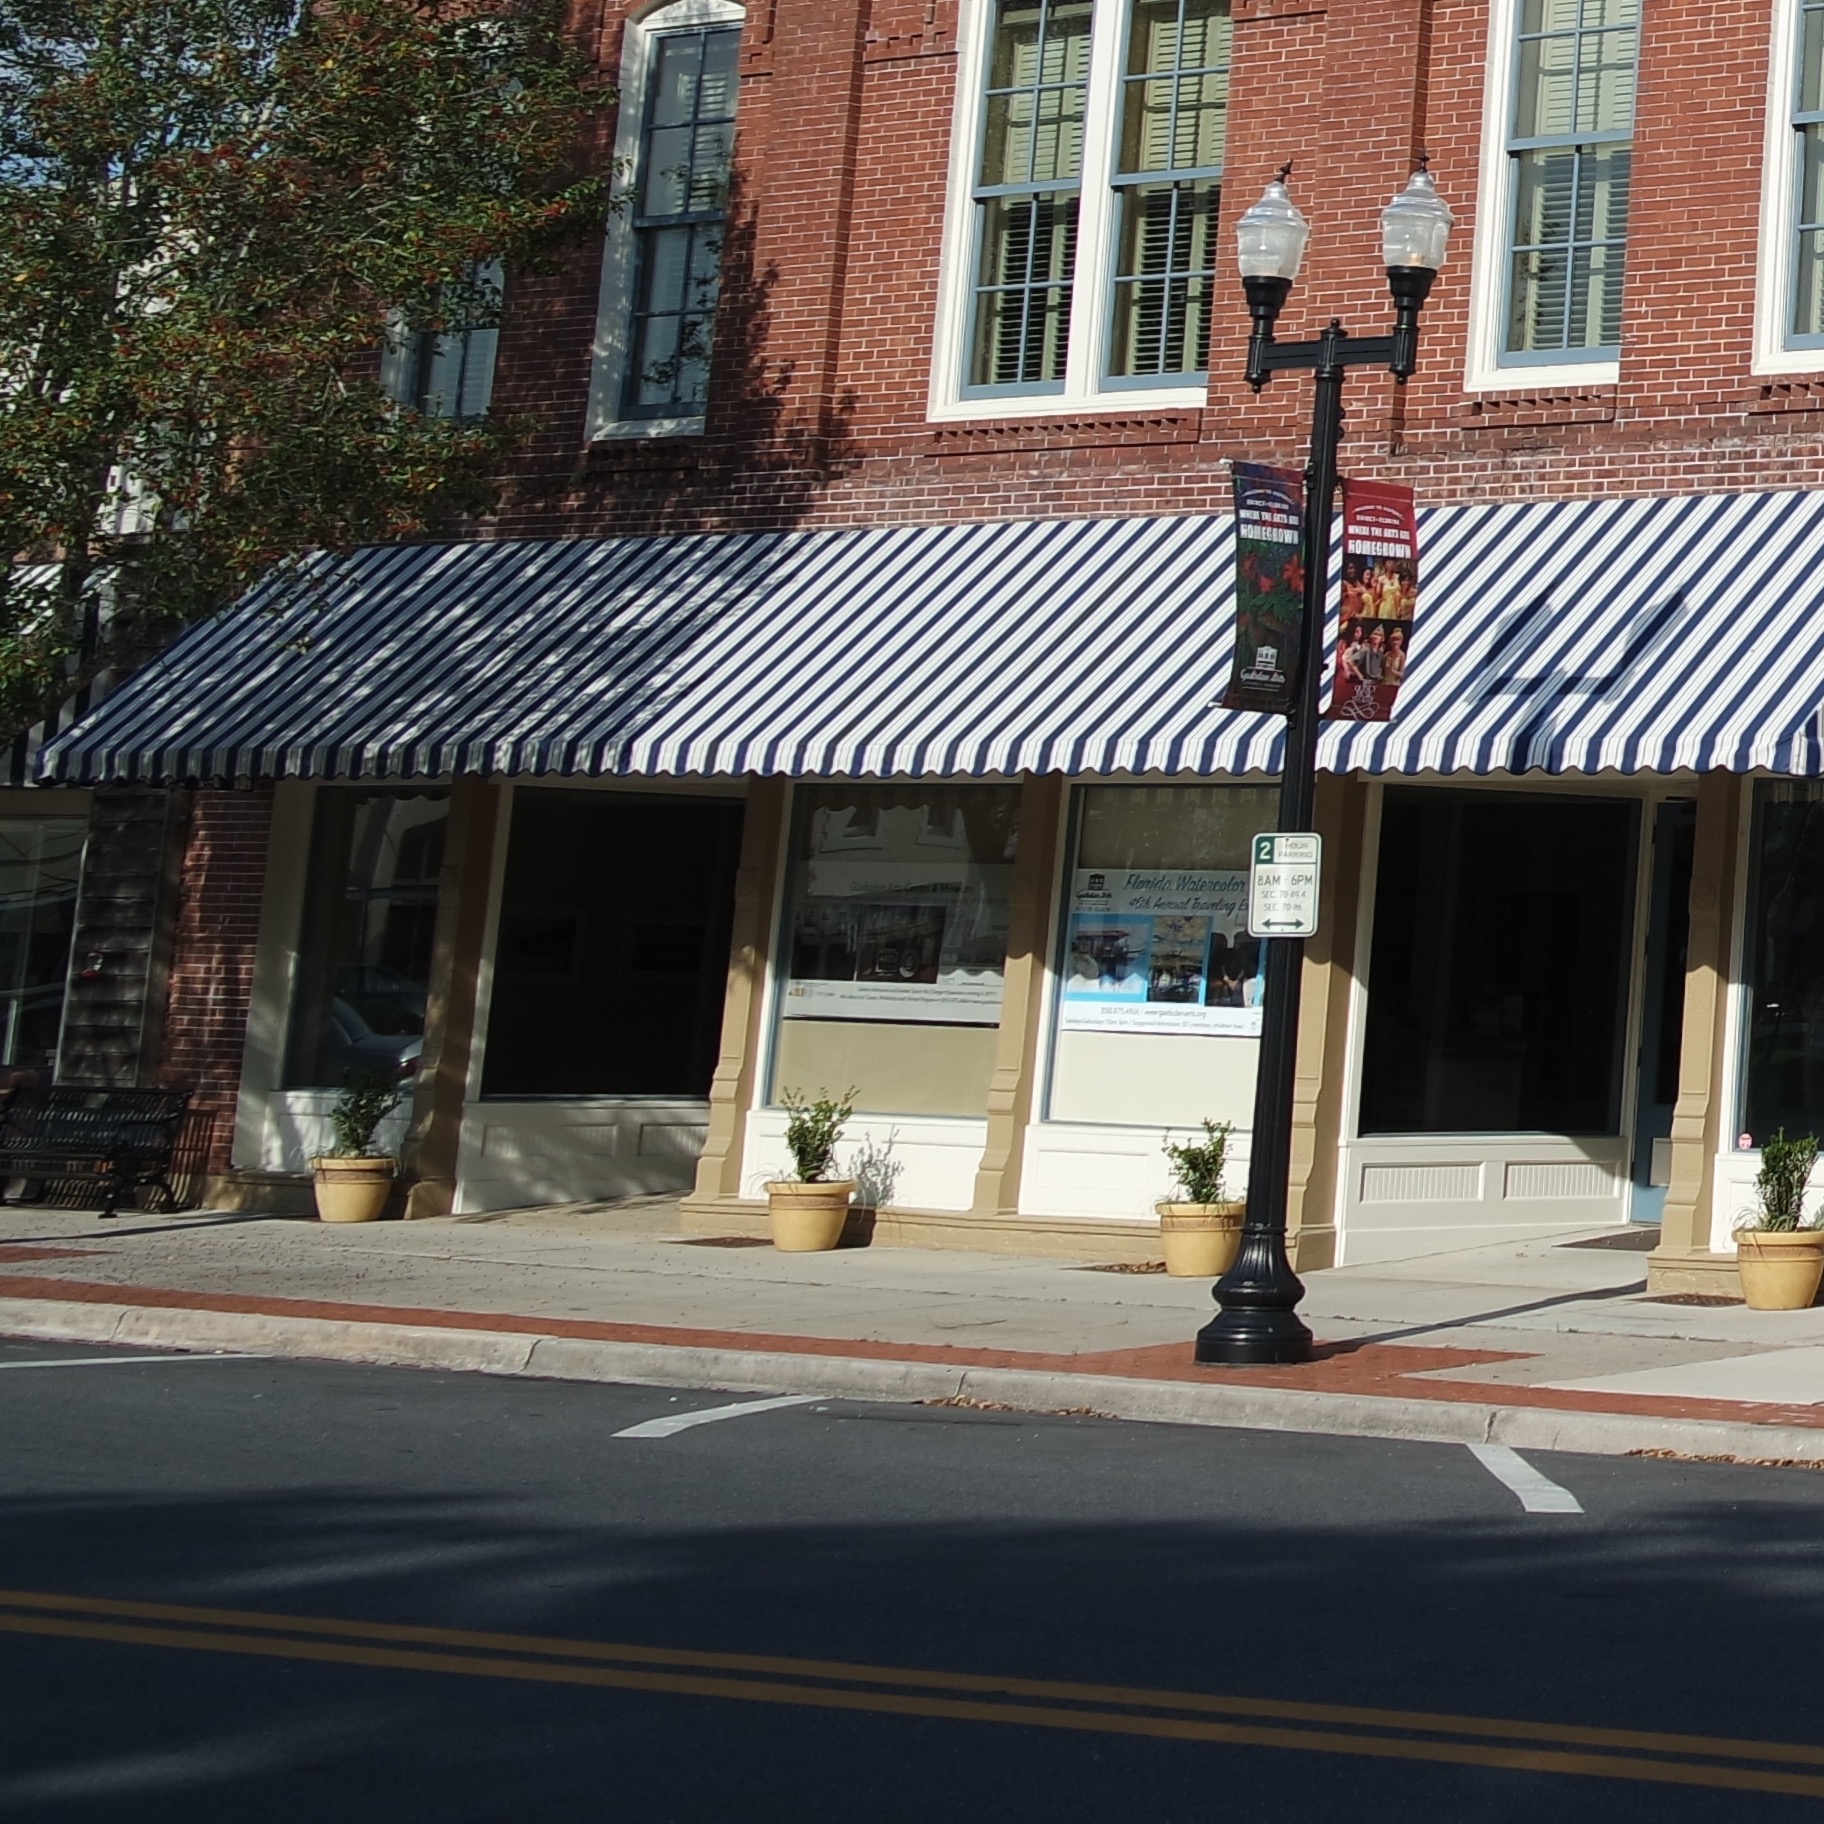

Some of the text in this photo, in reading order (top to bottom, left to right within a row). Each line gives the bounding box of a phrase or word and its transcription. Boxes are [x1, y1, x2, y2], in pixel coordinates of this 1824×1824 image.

[1240, 524, 1299, 545] HOMEGROWN
[1348, 540, 1411, 559] HOMEGROWN
[1259, 841, 1271, 860] 2
[1124, 874, 1246, 892] Florida Watercolor
[1258, 875, 1281, 886] 8AM
[1291, 875, 1313, 886] 6PM
